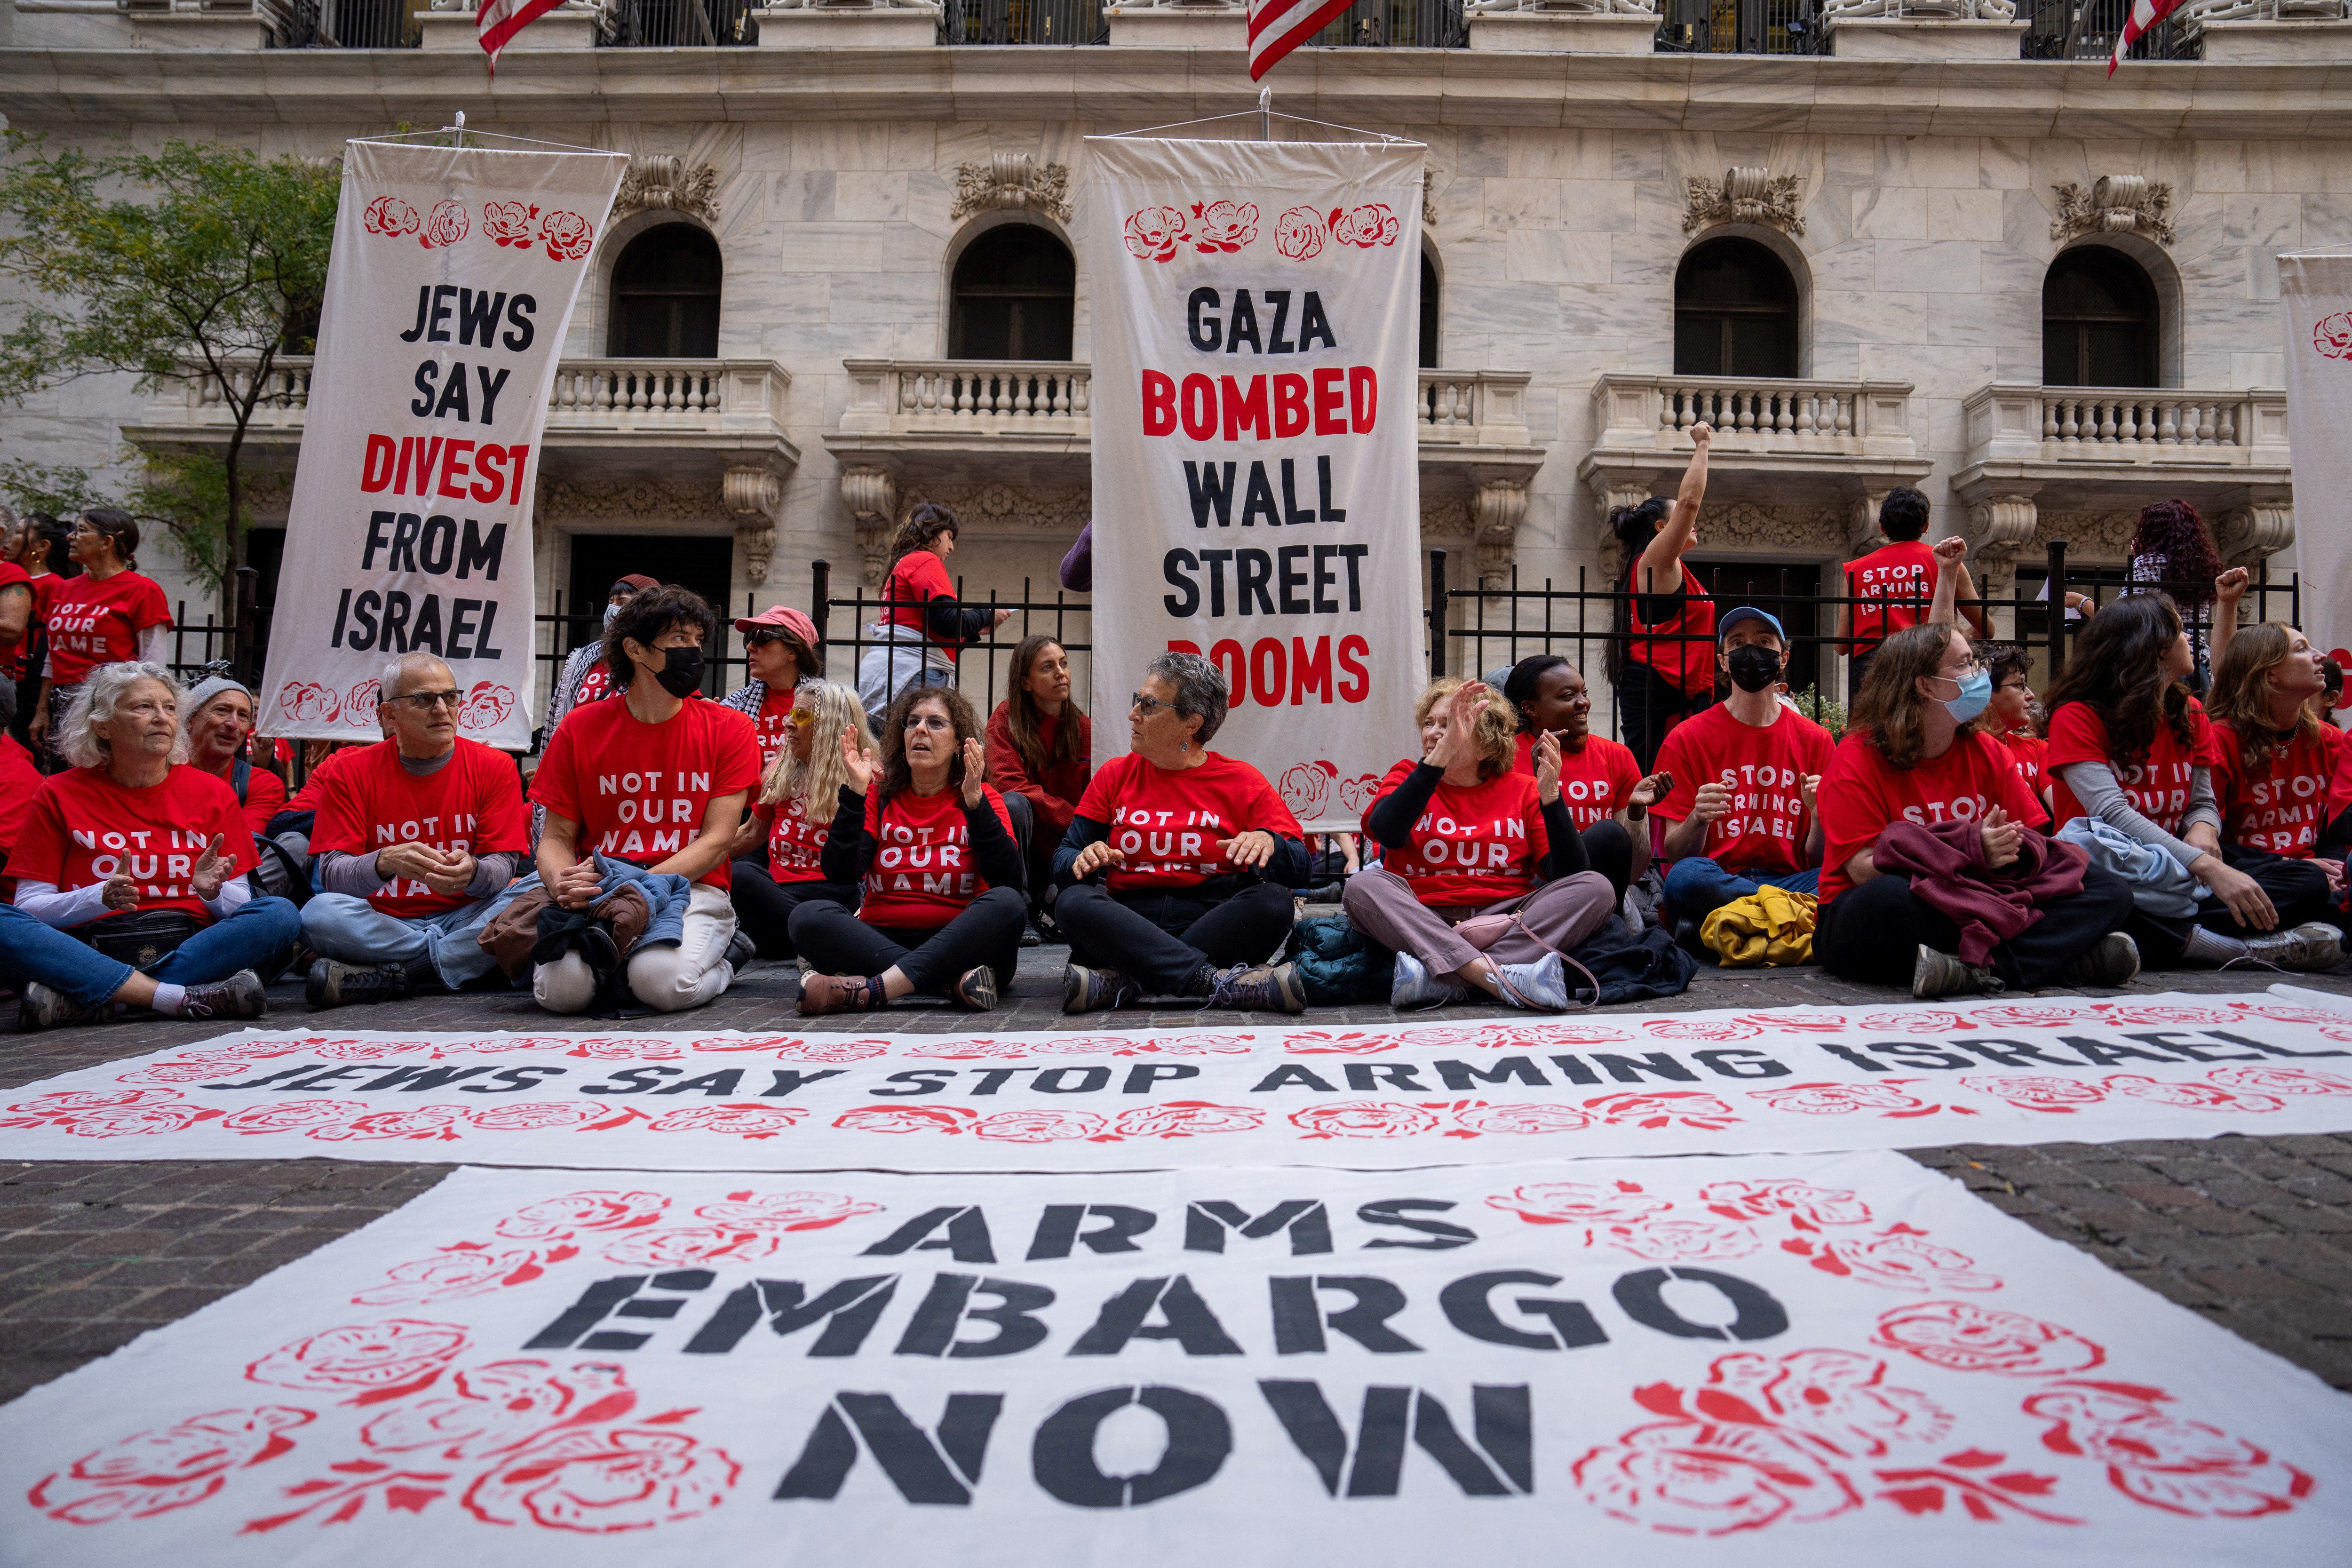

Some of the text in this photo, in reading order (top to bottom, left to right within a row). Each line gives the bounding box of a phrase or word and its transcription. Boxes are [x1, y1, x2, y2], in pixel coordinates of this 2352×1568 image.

[400, 284, 537, 352] JEWS
[1187, 287, 1337, 354] GAZA
[411, 359, 511, 425] SAY
[1142, 366, 1378, 441] BOMBED
[361, 434, 530, 506] DIVEST
[1183, 454, 1347, 528] WALL
[361, 510, 508, 581] FROM
[1163, 543, 1369, 618] STREET
[1863, 565, 1924, 583] STOP
[52, 603, 87, 614] OT
[49, 616, 95, 633] OUR
[331, 588, 502, 660] ISRAEL
[48, 635, 107, 653] AME
[599, 772, 709, 795] NOT IN
[1557, 780, 1609, 800] OP
[1721, 764, 1795, 790] STOP
[618, 799, 692, 824] OUR
[2123, 789, 2185, 814] OUR
[1113, 806, 1219, 828] NOT IN
[1414, 812, 1524, 839] NOT IN
[2241, 802, 2328, 829] ARMI
[72, 829, 207, 849] NOT IN
[376, 816, 439, 844] NOT
[779, 818, 829, 847] STO
[1120, 829, 1202, 857] OUR
[2237, 826, 2318, 851] ISRA
[91, 854, 191, 880] OUR
[880, 845, 961, 868] OUR
[1423, 839, 1509, 868] OUR
[869, 873, 975, 895] NAME
[197, 1031, 2352, 1097] JEWS SAY STOP ARMING ISRAEL
[860, 1199, 1478, 1264] ARMS
[521, 1268, 1790, 1358] EMBARGO
[772, 1380, 1534, 1508] NOW
